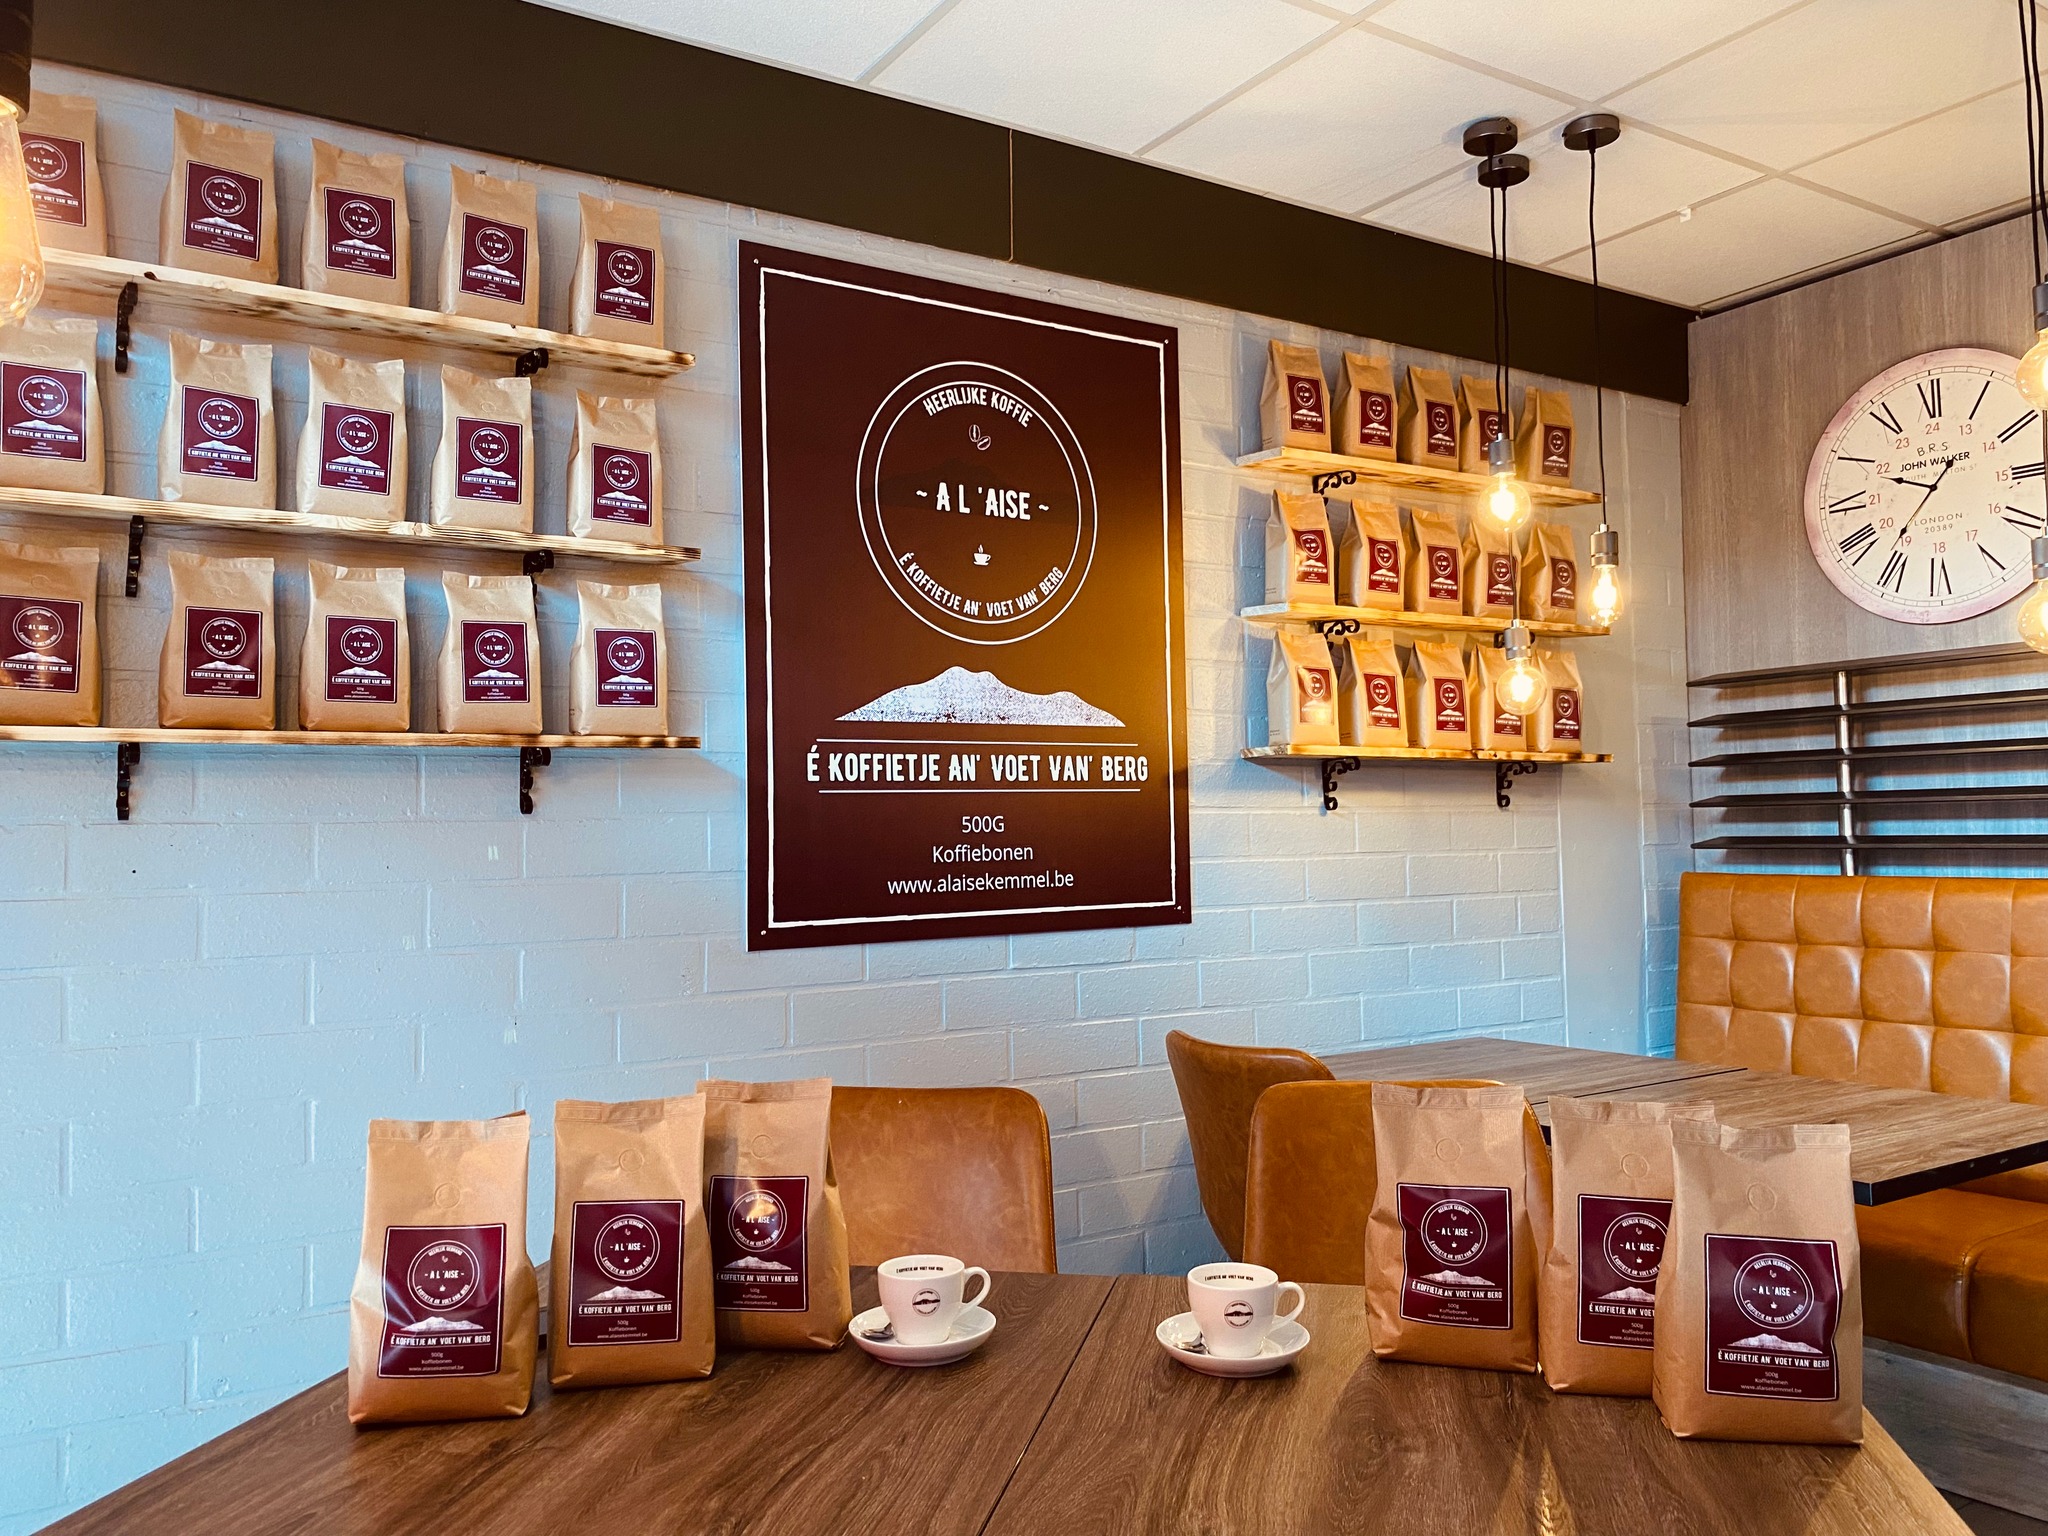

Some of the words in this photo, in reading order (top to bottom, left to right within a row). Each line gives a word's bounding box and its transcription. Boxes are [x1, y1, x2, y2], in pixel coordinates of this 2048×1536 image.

[922, 387, 987, 416] HEERLIJKE
[990, 391, 1034, 428] KOFFIE
[1925, 422, 1940, 435] 24
[1959, 424, 1973, 436] 13
[1895, 437, 1910, 450] 23
[1982, 441, 1996, 453] 14
[1900, 460, 1927, 472] JOHN
[1930, 451, 1970, 466] WALKER
[1876, 462, 1890, 475] 22
[1995, 470, 2009, 482] 15
[936, 482, 950, 511] A
[959, 484, 970, 514] L
[978, 486, 1030, 520] 'AISE
[1869, 494, 1881, 505] 21
[1988, 502, 2001, 514] 16
[1879, 518, 1894, 529] 20
[1914, 512, 1963, 526] LONDON
[1925, 524, 1953, 534] 20389
[1900, 536, 1912, 547] 19
[1965, 530, 1979, 542] 17
[1933, 541, 1946, 554] 18
[898, 552, 914, 566] É
[907, 564, 961, 612] KOFFIETJE
[964, 601, 983, 616] AN'
[986, 599, 1014, 617] VOET
[1015, 588, 1039, 612] VAN'
[1040, 565, 1064, 596] BERG
[807, 745, 820, 782] É
[828, 752, 940, 782] KOFFIETJE
[949, 754, 980, 781] AN'
[991, 755, 1040, 781] VOET
[1049, 756, 1094, 781] VAN'
[1101, 756, 1148, 781] BERG
[962, 815, 1004, 833] 500G
[933, 844, 1033, 864] Koffiebonen
[888, 870, 1074, 894] www.alaisekemmel.be
[430, 1270, 435, 1279] A
[1417, 1282, 1443, 1296] KOFFIETJE
[1759, 1286, 1764, 1294] A
[1595, 1304, 1625, 1314] KOFFIETJE
[396, 1337, 426, 1345] KOFFIETJE
[1725, 1352, 1759, 1363] KOFFIETJE
[1775, 1357, 1792, 1365] VOET
